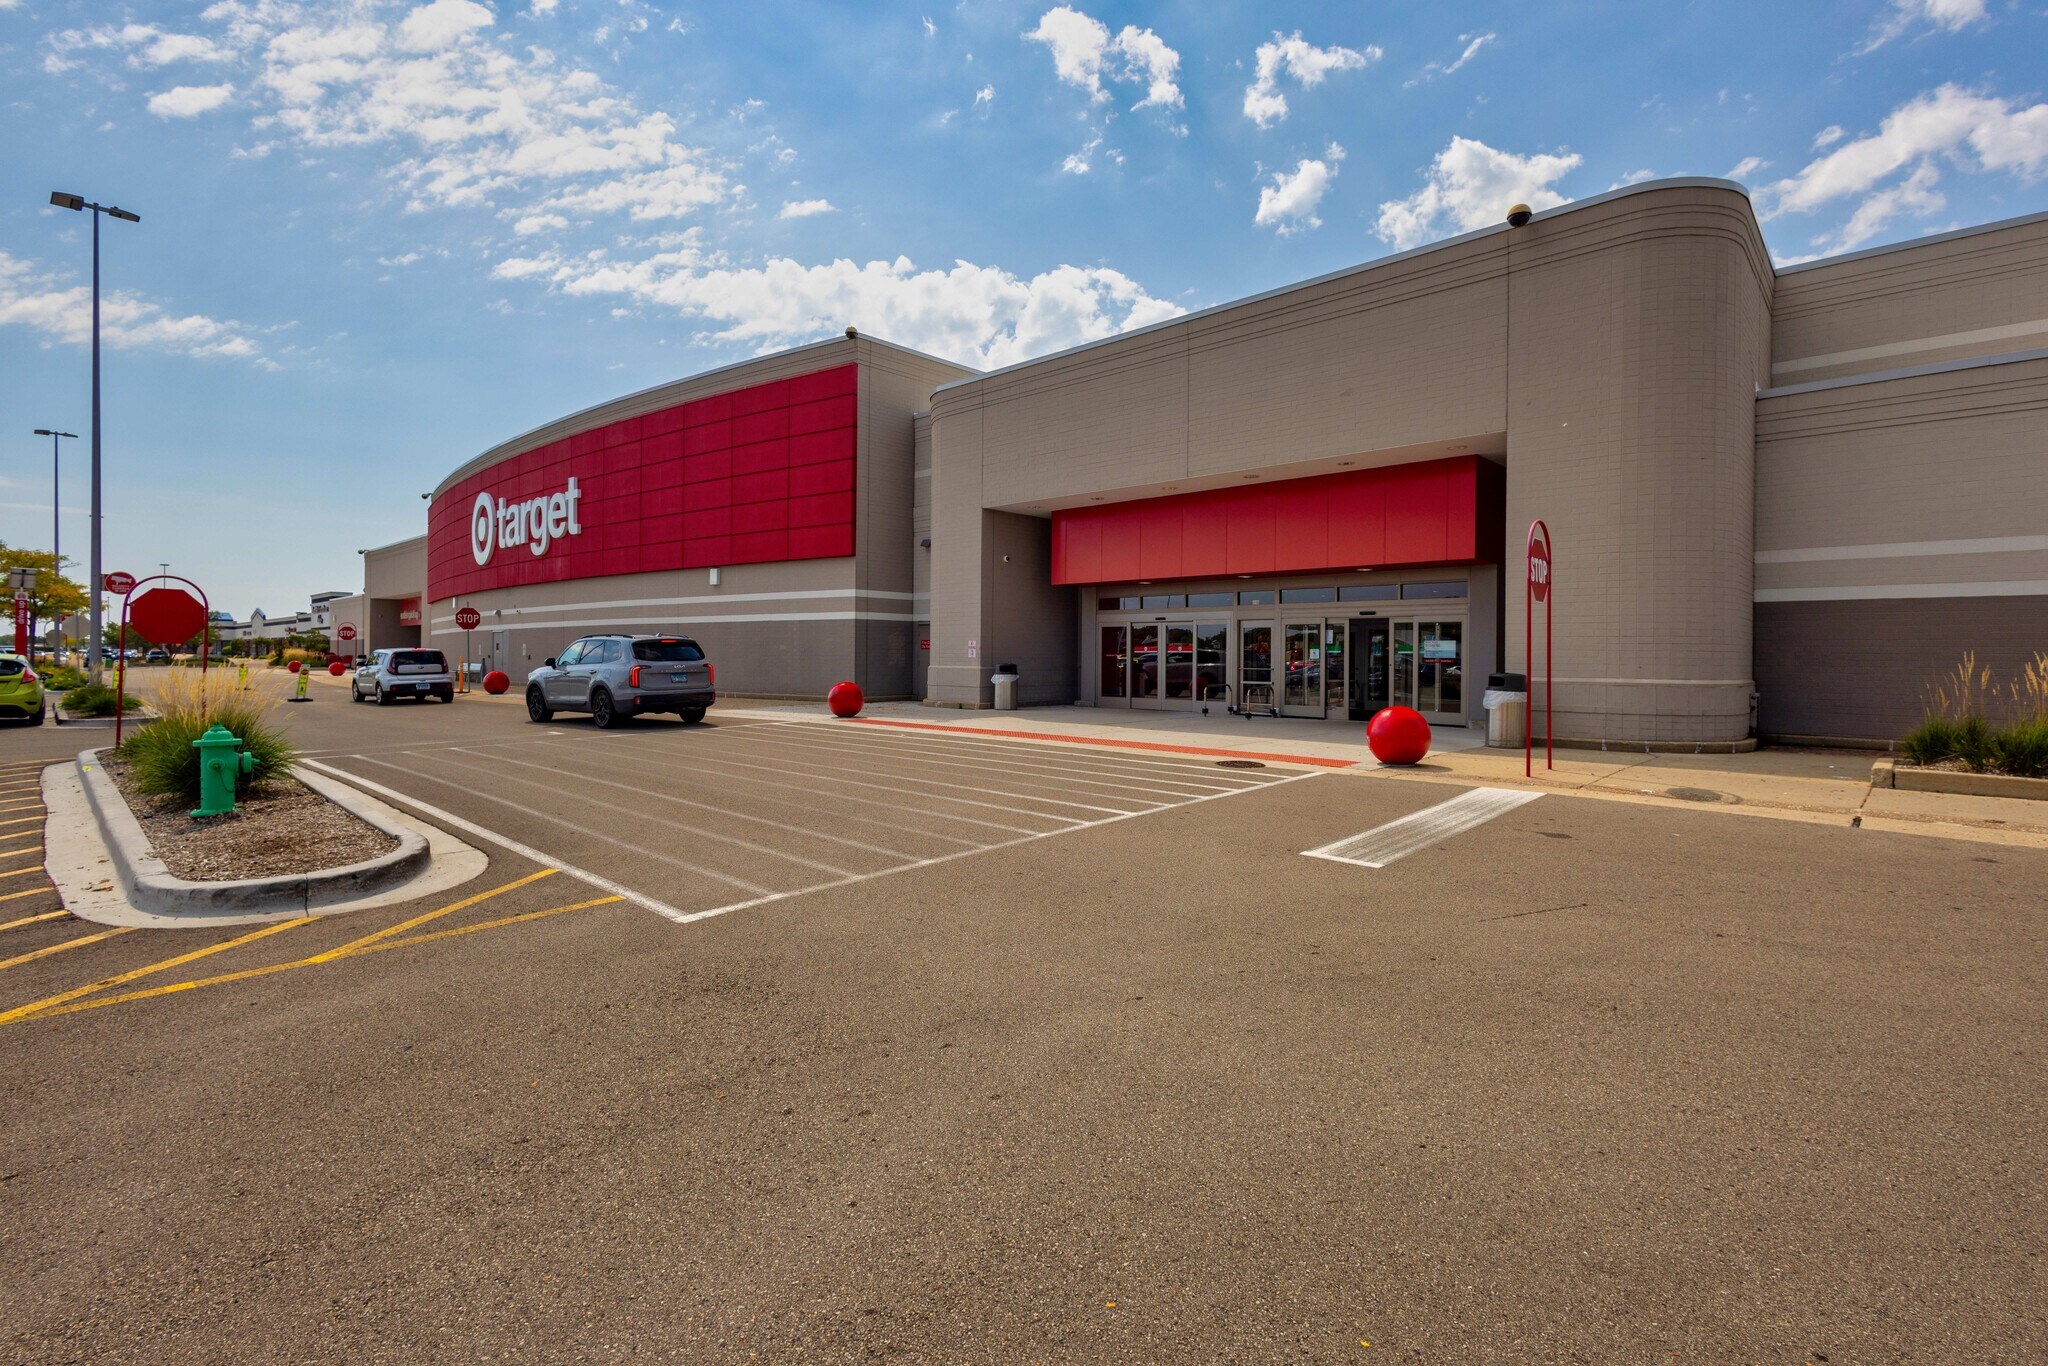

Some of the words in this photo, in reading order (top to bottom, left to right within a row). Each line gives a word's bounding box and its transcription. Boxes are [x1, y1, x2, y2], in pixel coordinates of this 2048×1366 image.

[497, 477, 581, 556] target
[1530, 556, 1548, 584] STOP
[457, 614, 480, 623] STOP
